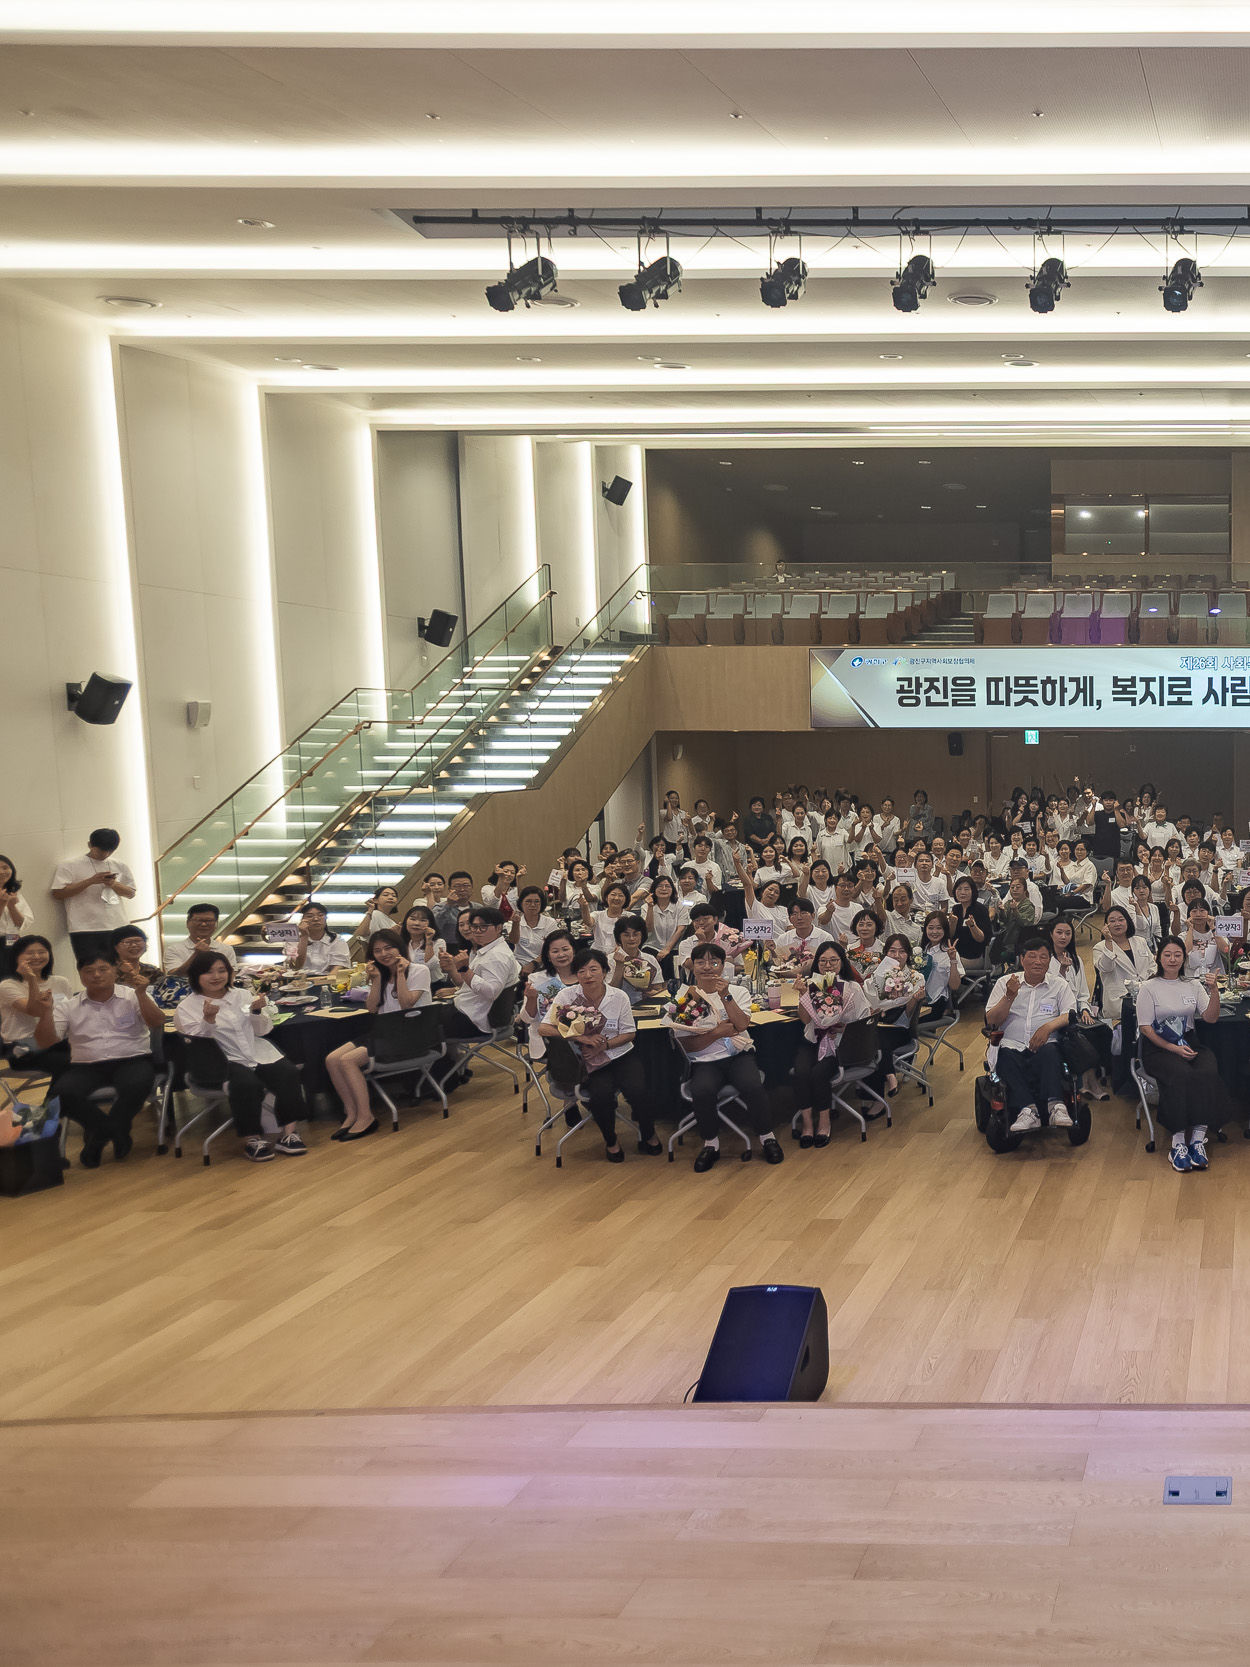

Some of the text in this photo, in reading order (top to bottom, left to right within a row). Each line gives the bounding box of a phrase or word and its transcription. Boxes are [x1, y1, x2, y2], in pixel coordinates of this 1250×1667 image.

[1180, 656, 1218, 671] 제26회
[895, 676, 977, 707] 광진을
[986, 676, 1102, 711] 따뜻하게,
[1111, 676, 1193, 707] 복지로
[745, 926, 771, 934] 수상자2
[1218, 923, 1241, 931] 수상자3
